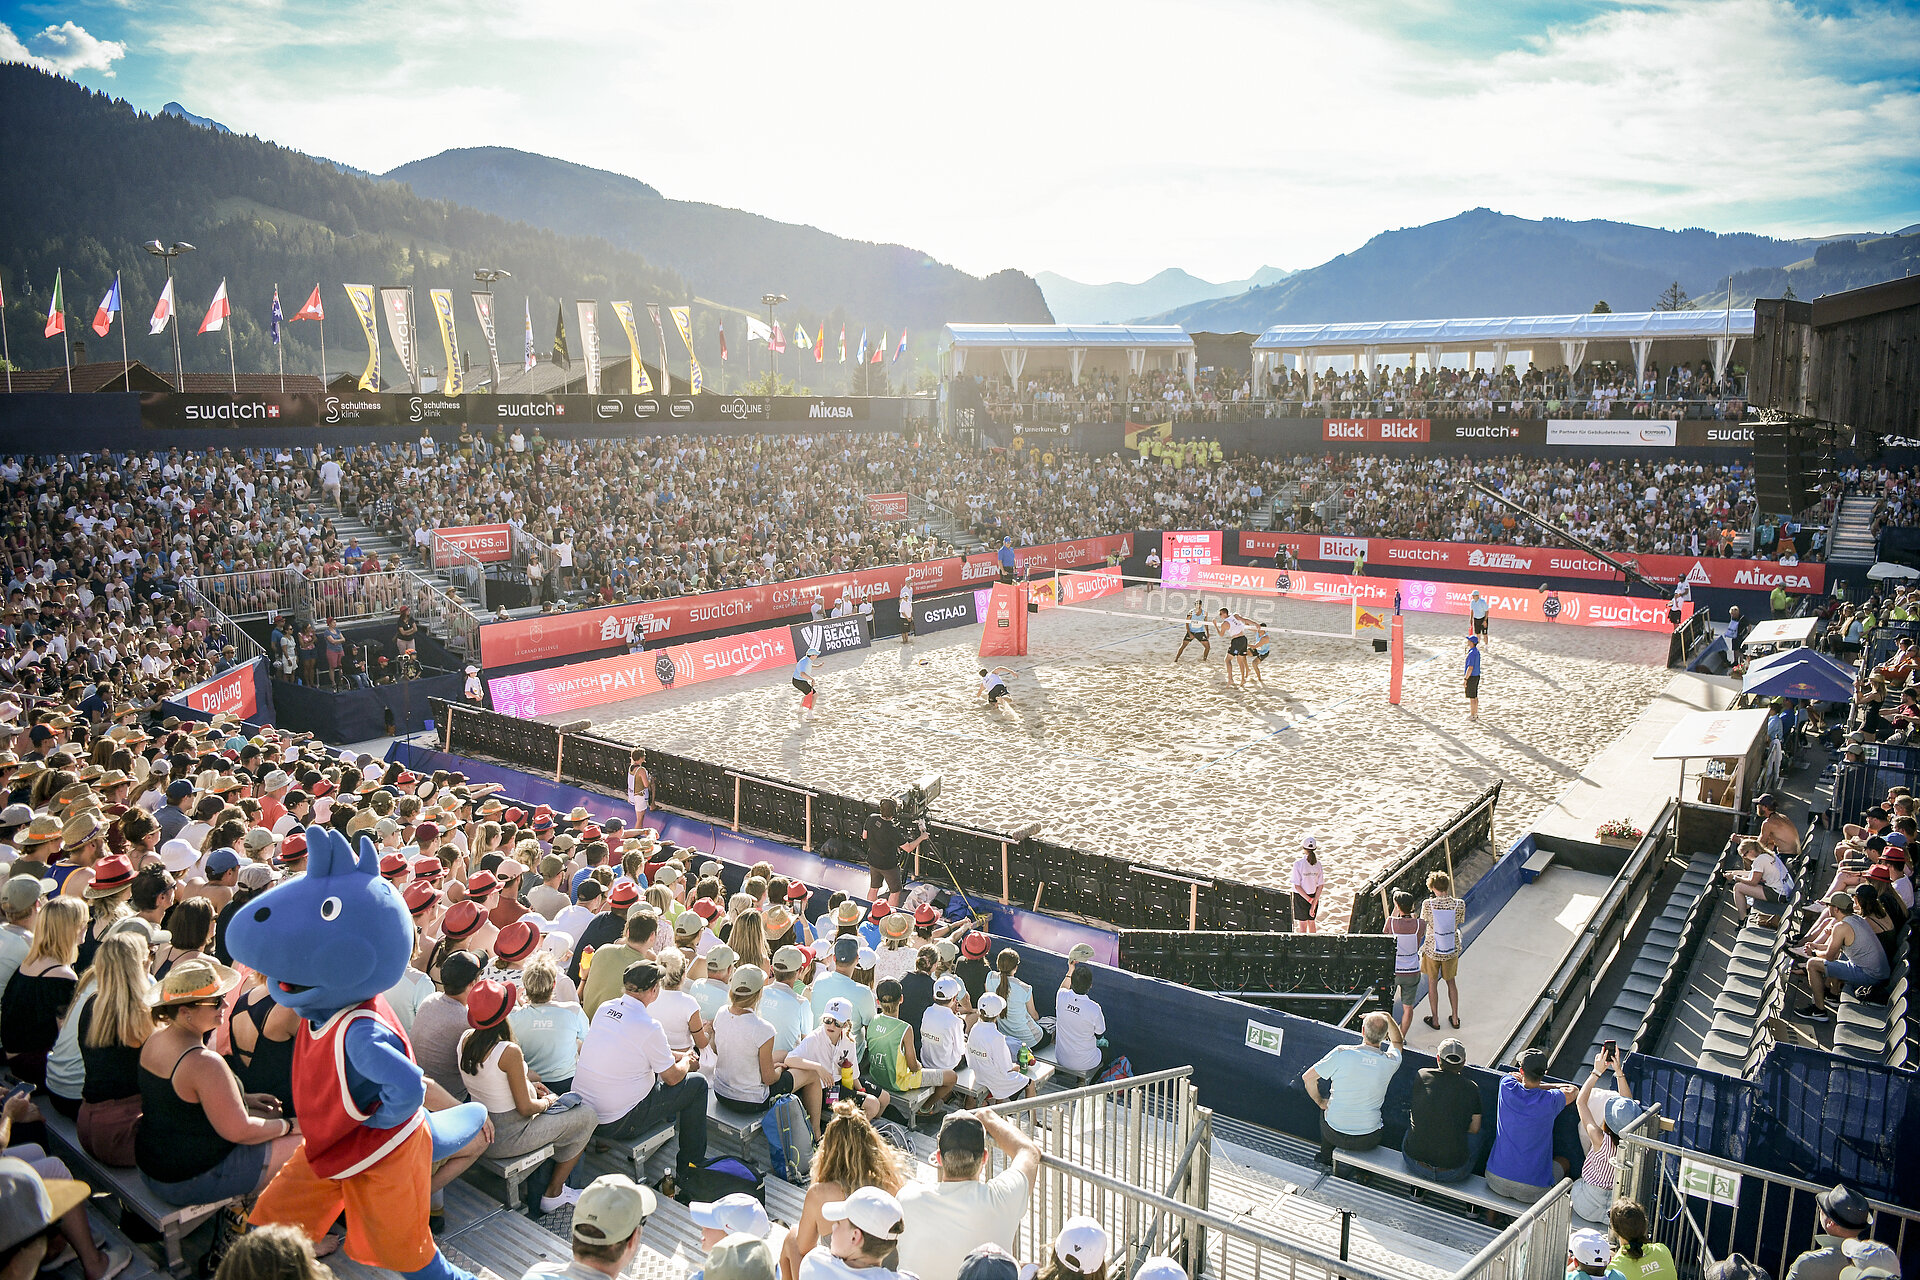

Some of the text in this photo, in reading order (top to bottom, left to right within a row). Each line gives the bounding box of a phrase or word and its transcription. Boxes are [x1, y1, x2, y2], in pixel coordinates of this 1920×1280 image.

[185, 402, 266, 419] swatch
[340, 401, 381, 410] schulthess
[423, 401, 460, 409] schulthess
[497, 402, 555, 417] swatch
[341, 410, 360, 418] klinik
[423, 409, 441, 417] klinik
[1328, 423, 1364, 438] Blick
[1381, 423, 1418, 438] Blick
[1455, 426, 1509, 438] swatch
[1323, 542, 1359, 557] Blick
[1388, 548, 1440, 560] swatch
[1468, 557, 1532, 569] BULLETIN
[1550, 558, 1608, 572] swatch
[908, 564, 943, 579] Daylong
[1197, 571, 1231, 581] SWATCH
[1231, 572, 1265, 588] PAY!
[772, 586, 821, 603] GSTAAD
[689, 600, 744, 622] swatch
[1488, 595, 1529, 612] PAY!
[620, 613, 654, 625] THE RED
[924, 605, 967, 623] GSTAAD
[1589, 605, 1666, 624] swatch
[823, 621, 844, 629] VOLLEYBALL
[824, 623, 860, 642] BEACH
[826, 637, 861, 651] PRO TOUR
[703, 639, 772, 670] swatch
[547, 666, 645, 694] SWATCH PAY!
[201, 679, 242, 712] Daylong
[606, 1008, 623, 1020] FIVB
[1640, 1260, 1660, 1274] FIVB
